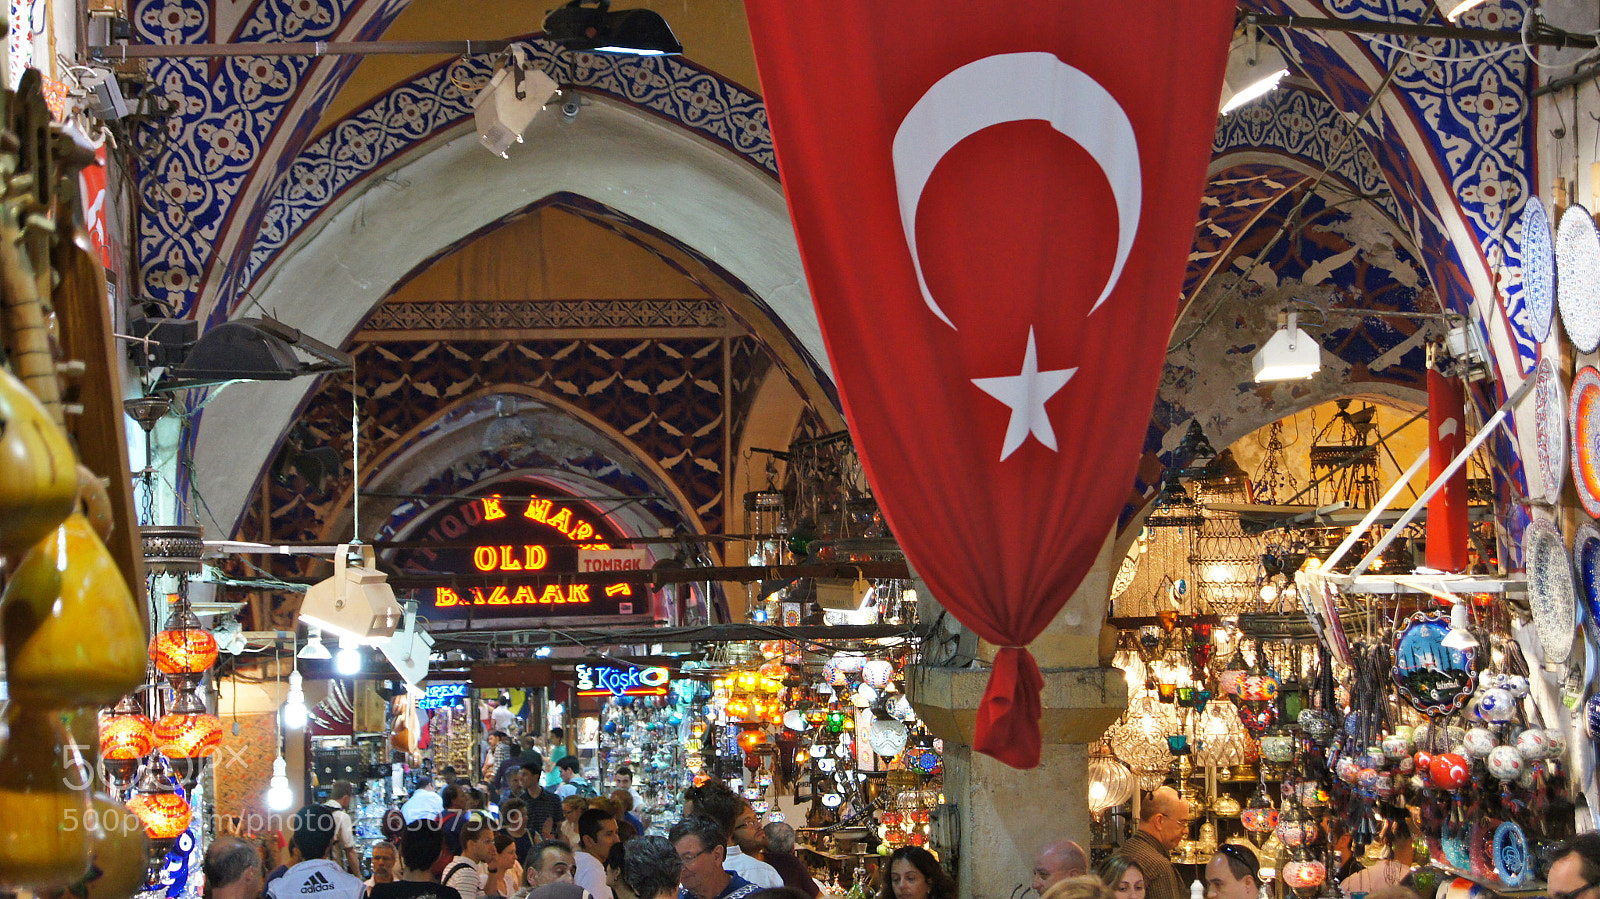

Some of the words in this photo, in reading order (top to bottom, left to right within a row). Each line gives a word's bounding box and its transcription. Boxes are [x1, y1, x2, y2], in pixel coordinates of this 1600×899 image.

[474, 545, 548, 571] OLD
[584, 558, 641, 573] TOMBAK
[300, 882, 335, 894] adidas
